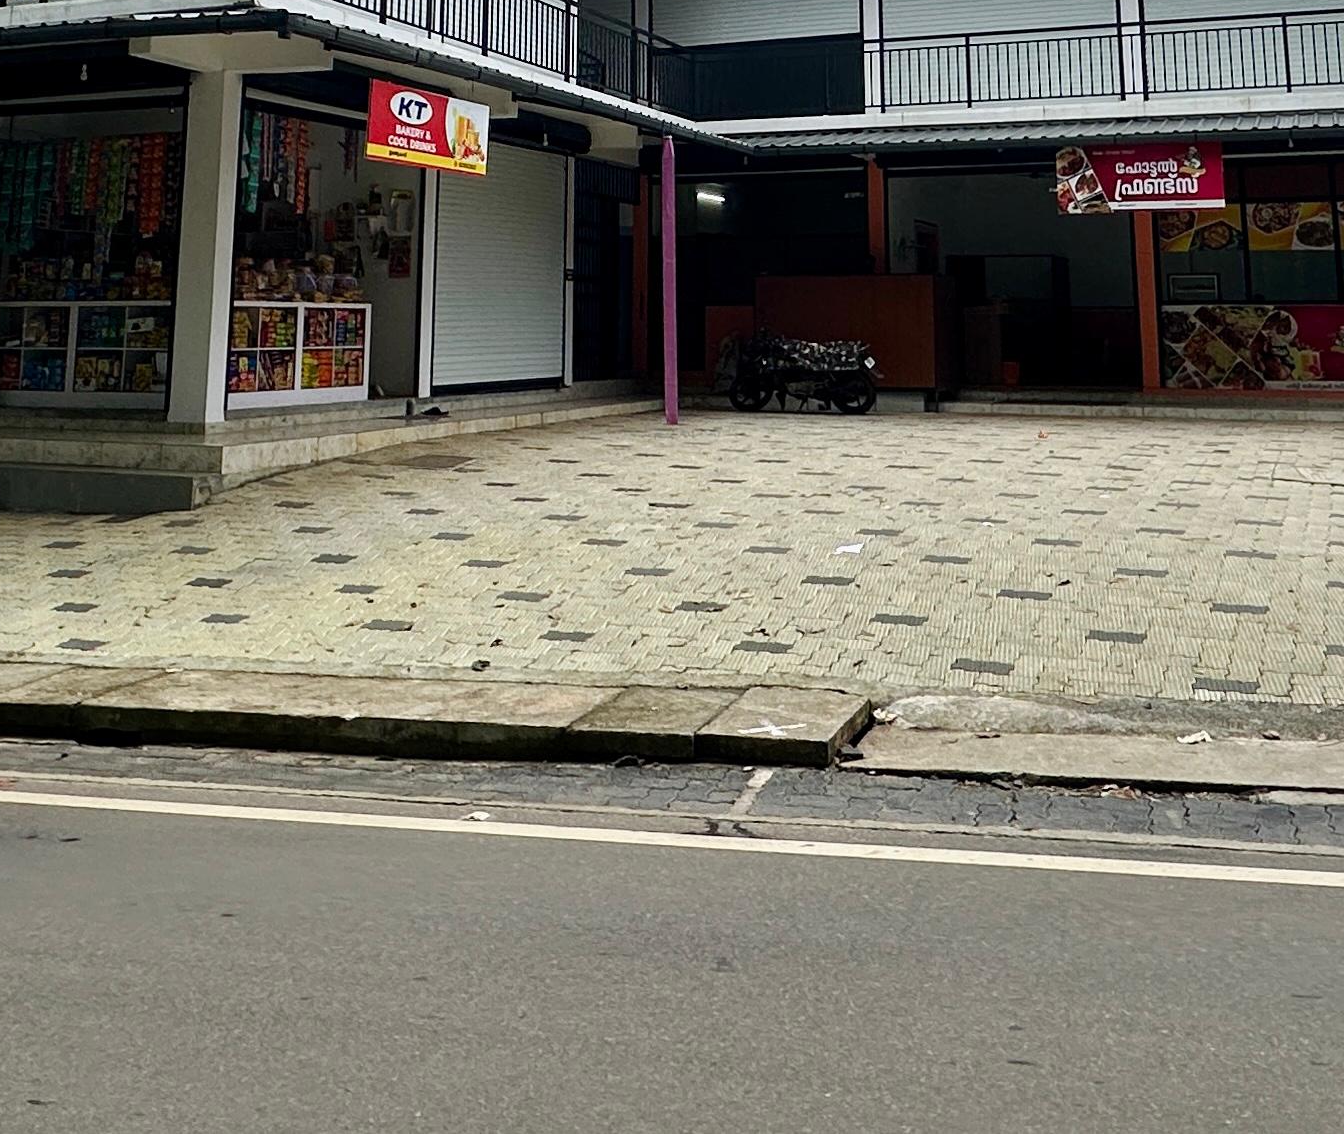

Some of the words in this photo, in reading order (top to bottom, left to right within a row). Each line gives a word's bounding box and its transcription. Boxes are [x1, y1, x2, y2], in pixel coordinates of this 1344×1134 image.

[397, 97, 428, 120] KT
[395, 124, 425, 139] BAKERY
[424, 130, 432, 141] &
[387, 134, 409, 149] COOL
[409, 138, 437, 154] DRINKS
